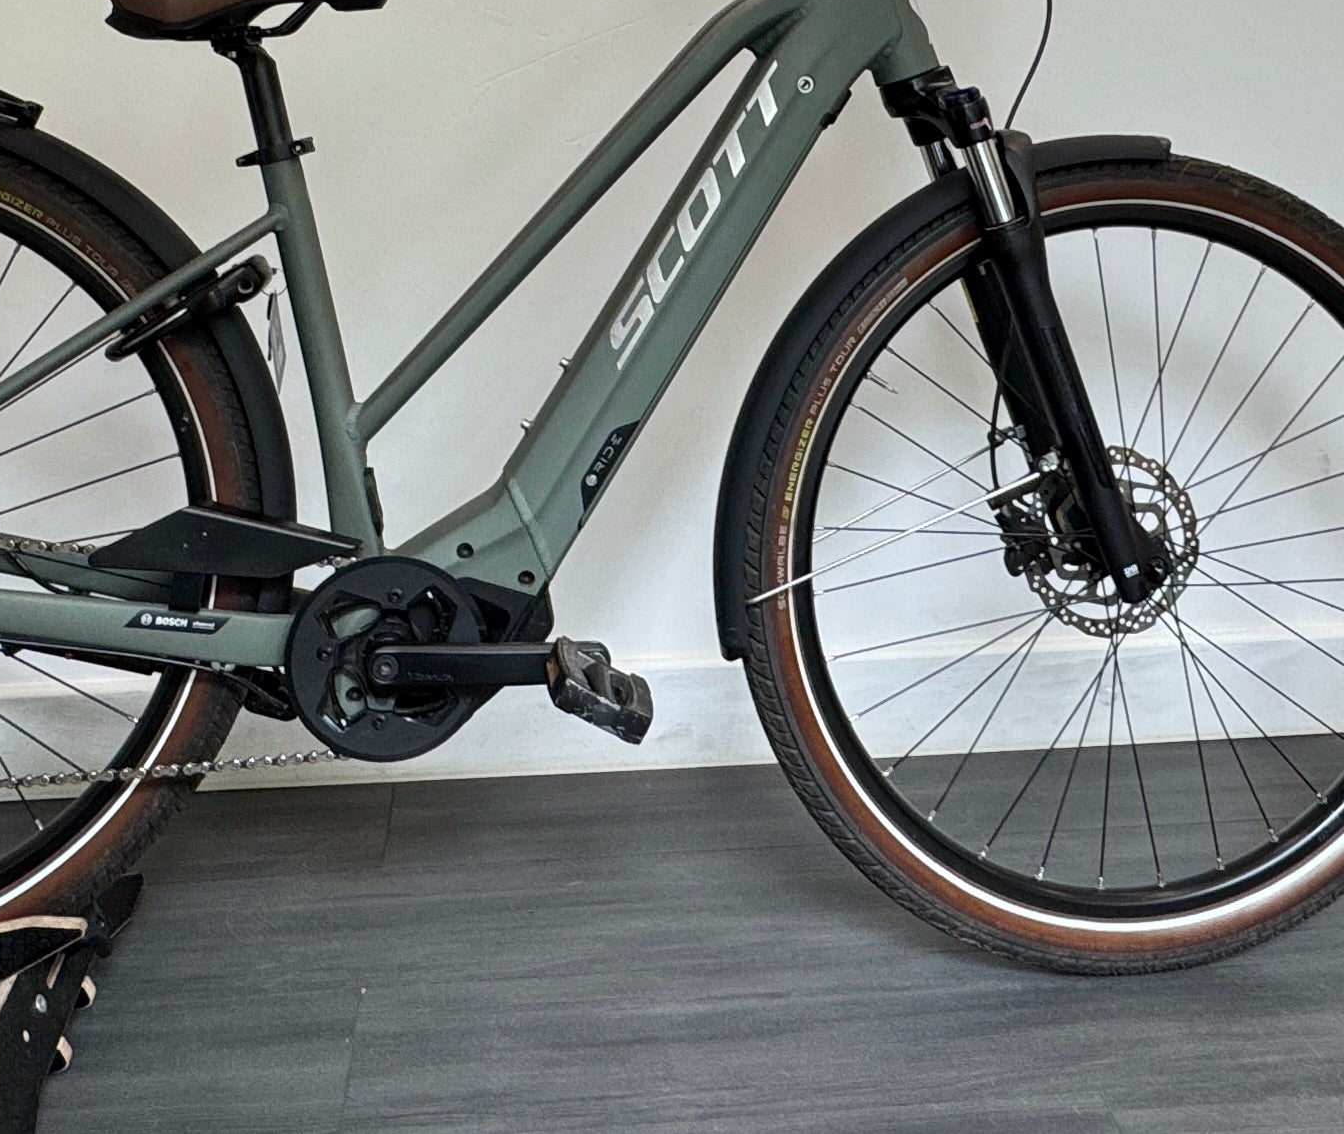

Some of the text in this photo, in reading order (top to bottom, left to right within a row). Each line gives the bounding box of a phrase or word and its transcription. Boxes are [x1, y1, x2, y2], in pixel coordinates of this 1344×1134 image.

[609, 60, 778, 370] SCOTT
[810, 378, 832, 416] PLUS
[829, 336, 856, 372] TOUR
[155, 616, 189, 628] BOSCH
